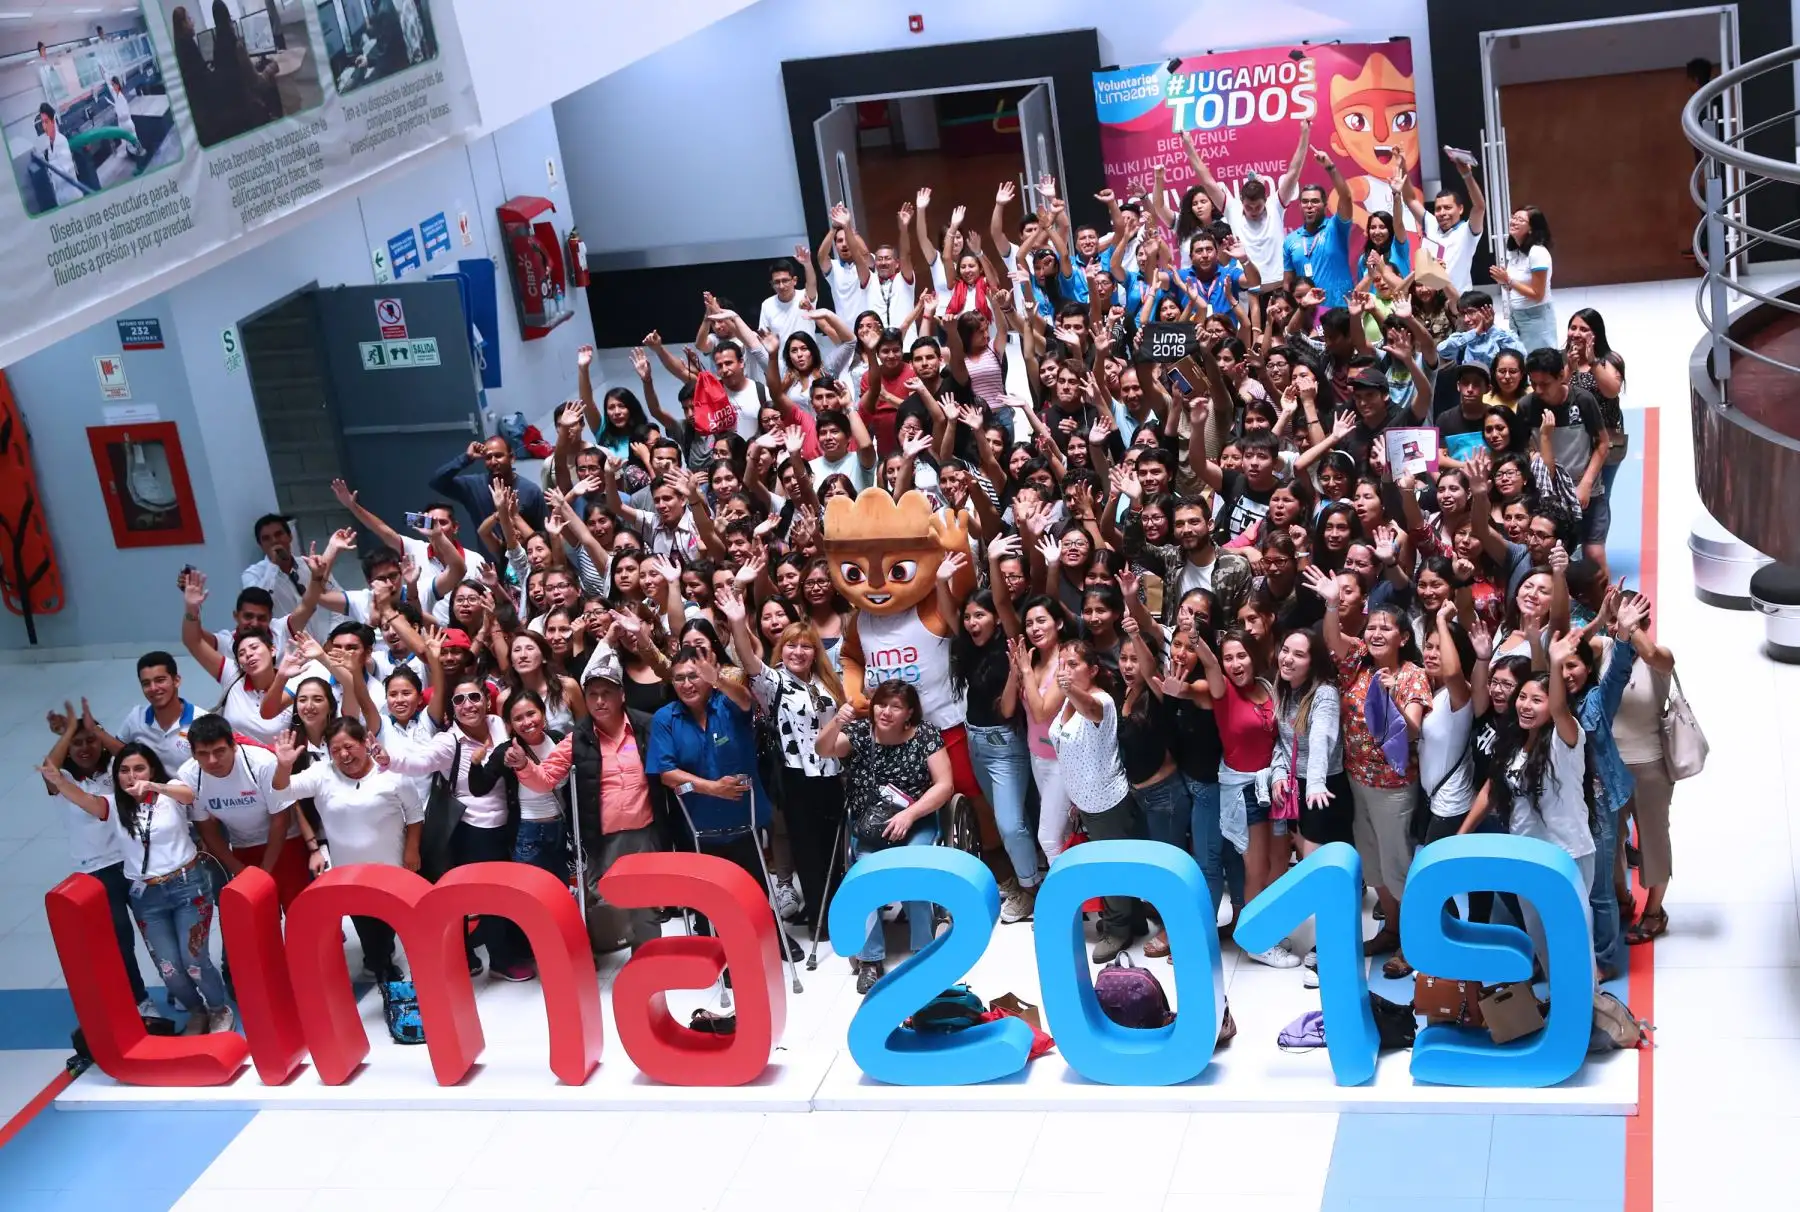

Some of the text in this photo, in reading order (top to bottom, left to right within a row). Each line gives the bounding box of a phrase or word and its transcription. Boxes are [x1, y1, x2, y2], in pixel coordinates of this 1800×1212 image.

[1098, 74, 1159, 92] Voluntarios
[1167, 57, 1315, 96] #JUGAMOS
[1166, 84, 1316, 132] TODOS
[208, 158, 233, 181] Aplica
[275, 128, 312, 150] avanzadas
[280, 146, 306, 167] modela
[306, 141, 320, 156] una
[272, 174, 288, 195] para
[288, 166, 308, 182] hacer
[1216, 160, 1288, 179] BEKANWE
[50, 178, 178, 244] Diseña una estructura para la
[240, 198, 277, 223] eficientes
[277, 192, 290, 208] sus
[48, 194, 192, 268] conducción y almacenamiento de
[54, 261, 87, 287] fluidos
[88, 258, 95, 272] a
[96, 245, 130, 274] presión
[129, 244, 137, 258] y
[138, 234, 152, 255] por
[131, 326, 150, 336] 232
[223, 330, 235, 352] S
[412, 343, 436, 354] SALIDA
[1152, 344, 1186, 357] 2019
[826, 832, 1596, 1088] 2019
